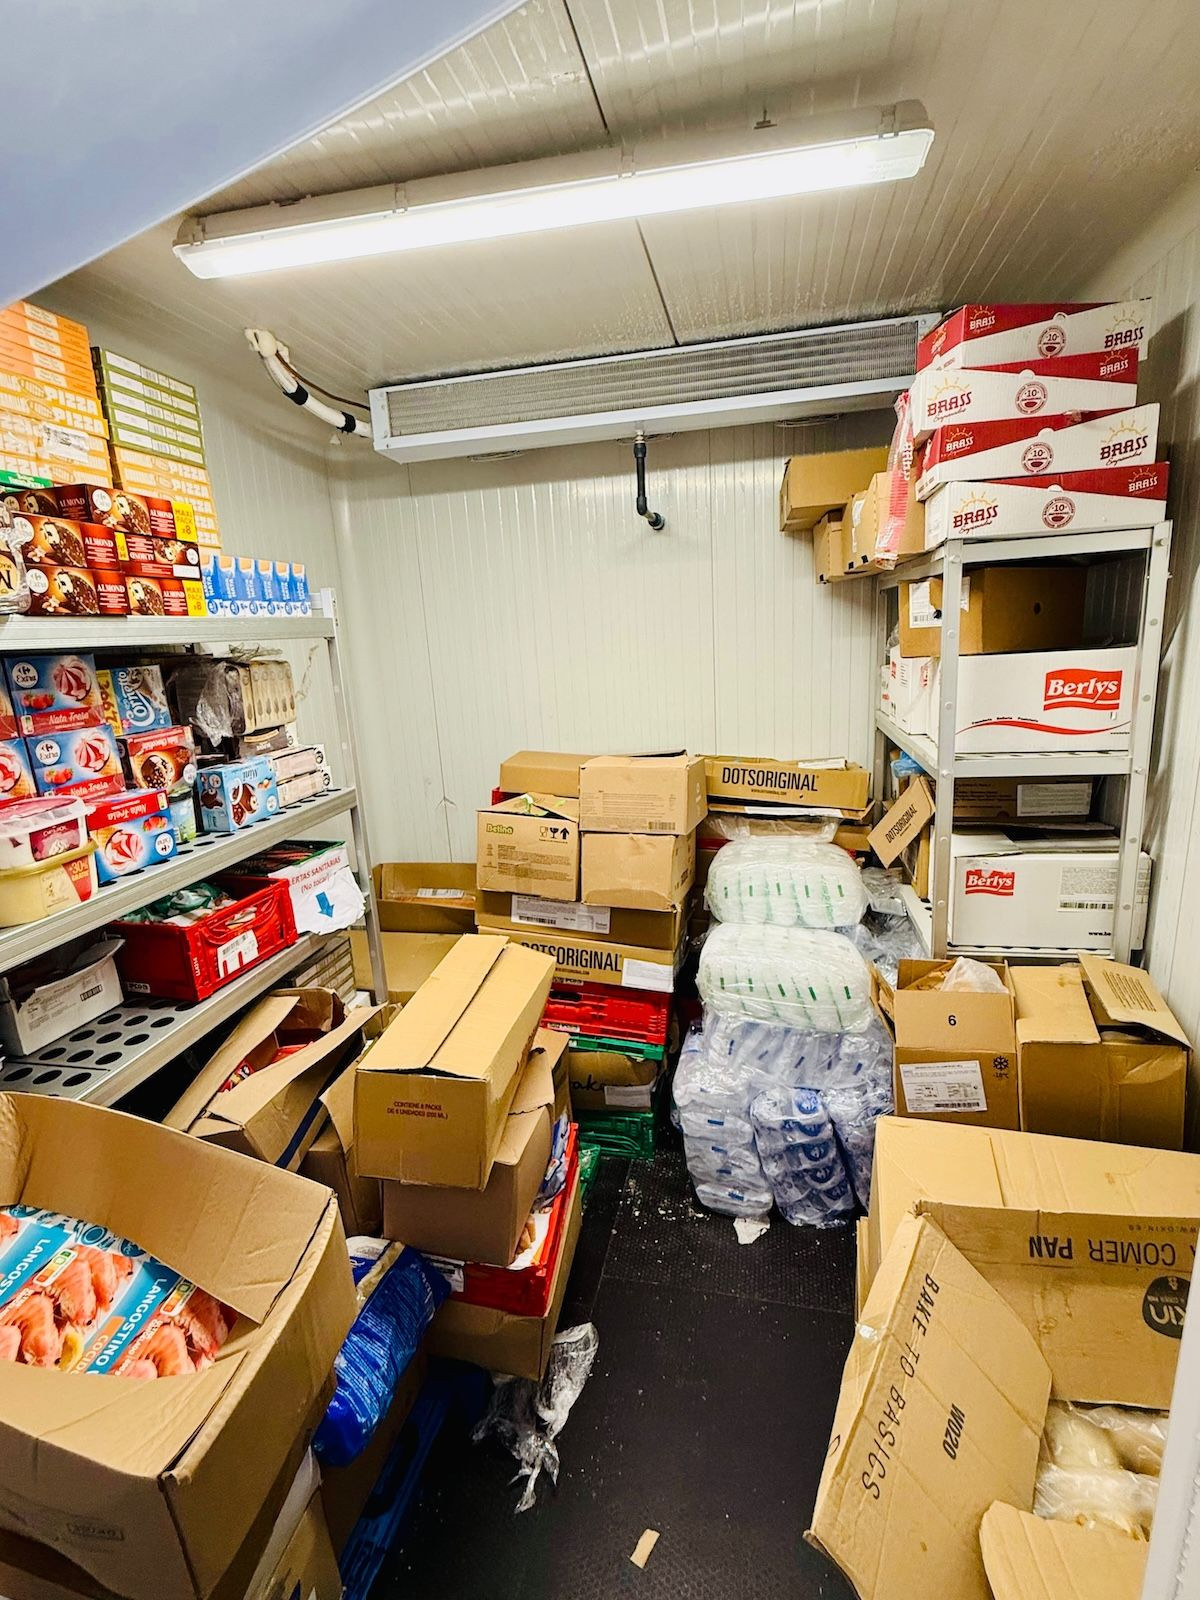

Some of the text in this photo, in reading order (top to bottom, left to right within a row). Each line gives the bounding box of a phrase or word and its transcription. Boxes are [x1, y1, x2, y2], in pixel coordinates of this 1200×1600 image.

[970, 315, 996, 330] BRASS
[1046, 333, 1057, 341] 10
[1104, 326, 1144, 349] BRASS
[1100, 359, 1128, 376] BRASS
[45, 385, 99, 416] PIZZA
[1027, 389, 1038, 397] 10
[927, 391, 972, 417] BRASS
[52, 406, 105, 435] PIZZA
[946, 436, 974, 453] BRASS
[1032, 449, 1043, 457] 10
[1100, 435, 1148, 460] BRASS
[1128, 476, 1158, 492] BRASS
[59, 498, 86, 508] ALMOND
[150, 509, 174, 519] ALMOND
[175, 509, 193, 517] MAXI
[953, 505, 999, 528] BRASS
[84, 536, 114, 548] ALMOND
[129, 551, 155, 561] ALMOND
[97, 584, 126, 593] ALMOND
[163, 590, 185, 599] ALMOND
[1047, 677, 1118, 702] Berlys
[118, 671, 155, 727] Cornetto
[50, 711, 89, 725] Nata Fresa
[722, 767, 818, 792] DOTSORIGINAL
[70, 786, 89, 797] Nata
[107, 803, 147, 821] Nata Fresa
[886, 804, 918, 845] DOTSORIGINAL
[290, 856, 341, 886] ERTAS SANITARIAS
[968, 874, 1013, 892] Berlys
[521, 942, 622, 972] TSORIGINAL
[948, 1014, 957, 1026] 6
[393, 1101, 420, 1109] CONTIENE
[425, 1103, 442, 1111] PACKS
[400, 1109, 425, 1117] UNIDADES
[1029, 1235, 1176, 1266] COMER PAN
[94, 1278, 168, 1367] LANGOSTINO
[861, 1272, 940, 1500] BAKE TO BASICS
[942, 1403, 966, 1461] W020
